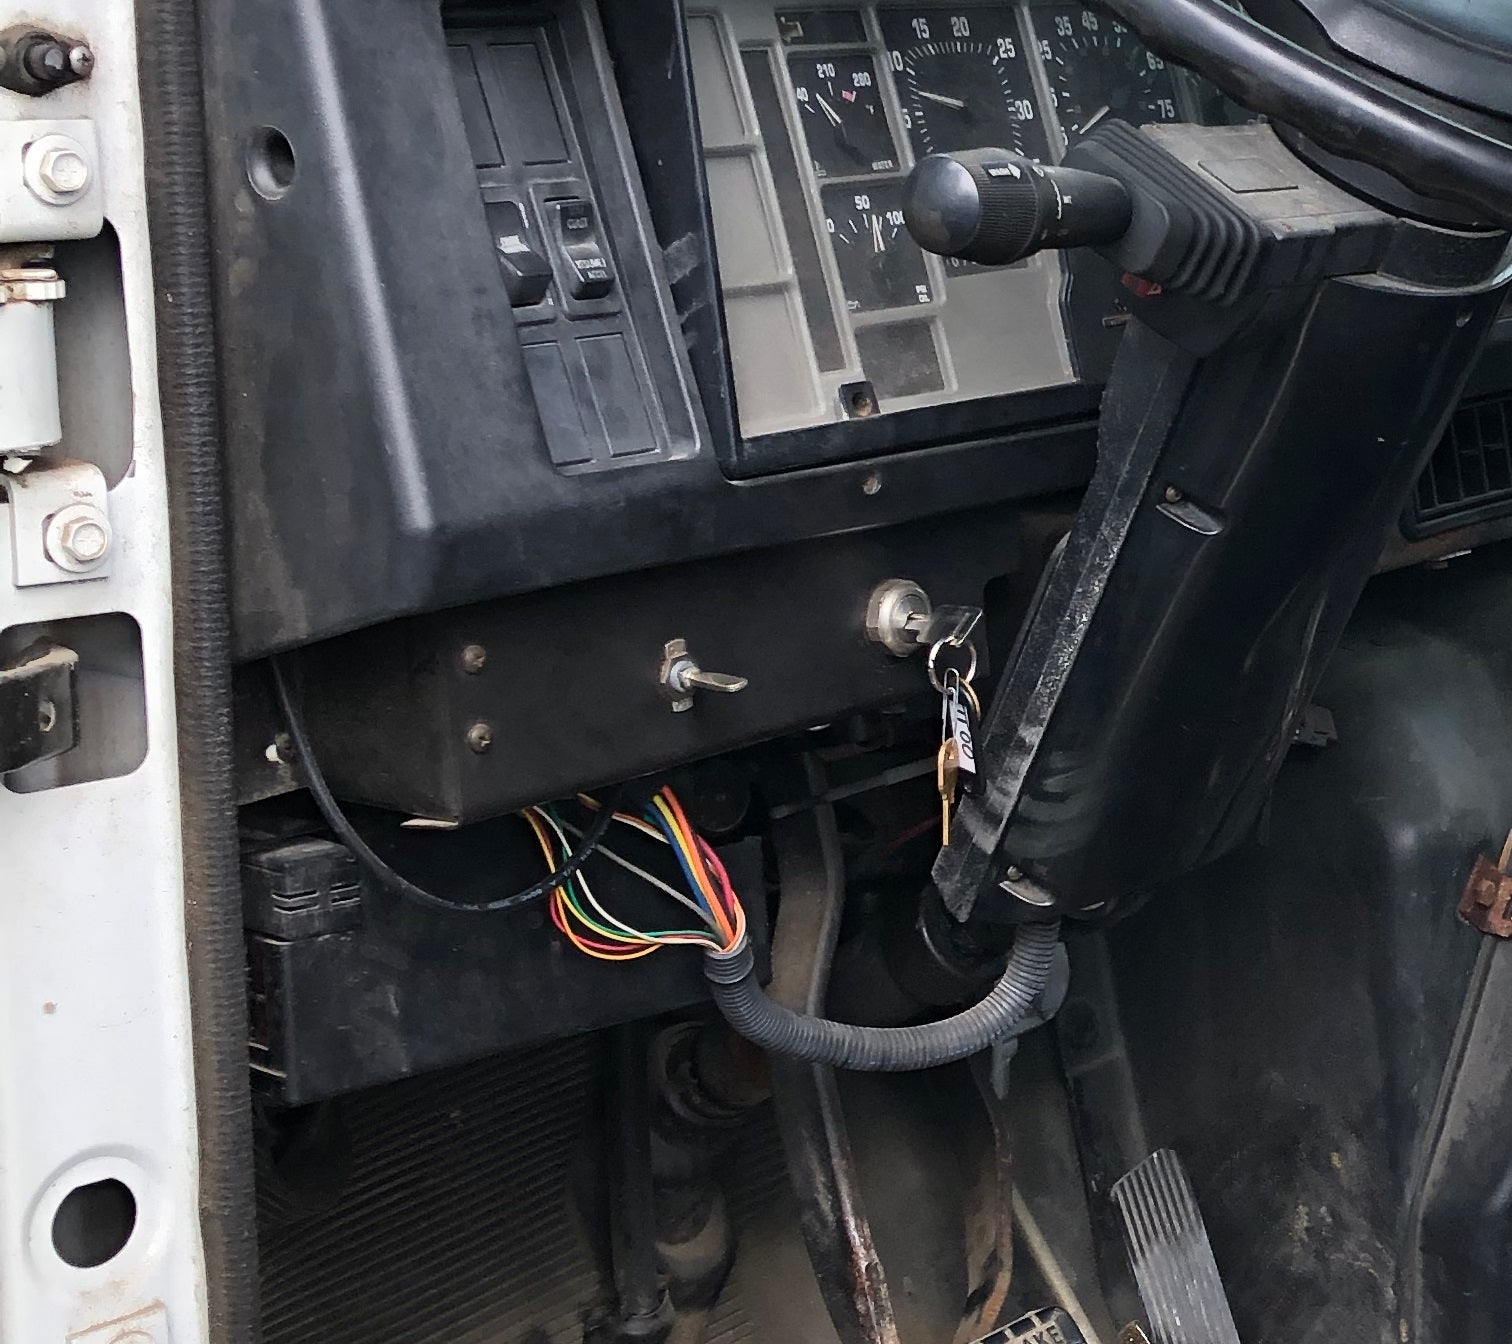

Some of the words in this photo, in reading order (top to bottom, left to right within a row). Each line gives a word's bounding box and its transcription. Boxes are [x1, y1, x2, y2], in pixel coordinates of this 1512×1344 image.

[911, 18, 930, 40] 15
[950, 16, 970, 38] 20
[1055, 16, 1073, 37] 35
[1081, 10, 1098, 31] 45
[997, 38, 1016, 58] 25
[816, 63, 835, 78] 210
[887, 50, 903, 72] 10
[1015, 99, 1034, 120] 30
[1157, 99, 1175, 118] 75
[854, 195, 871, 210] 50
[825, 218, 835, 234] 0
